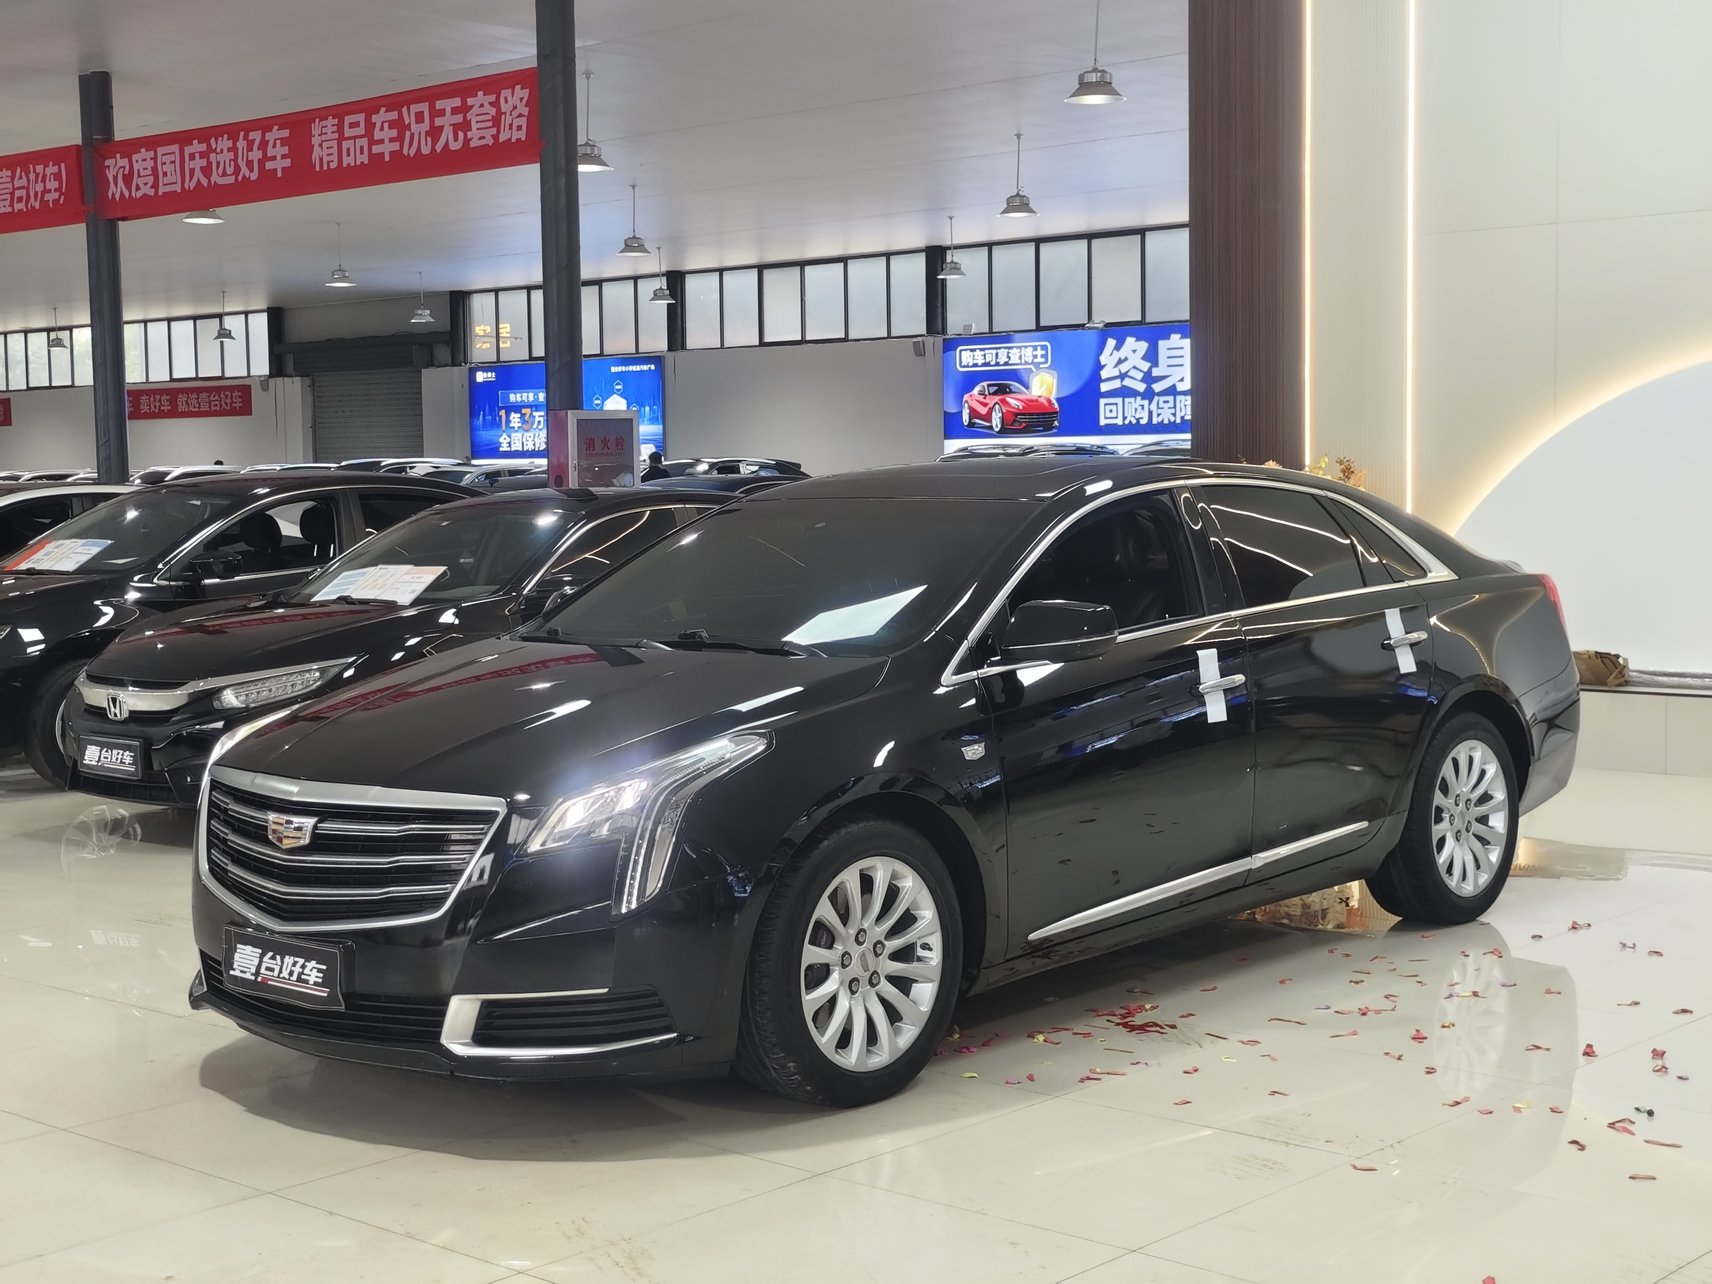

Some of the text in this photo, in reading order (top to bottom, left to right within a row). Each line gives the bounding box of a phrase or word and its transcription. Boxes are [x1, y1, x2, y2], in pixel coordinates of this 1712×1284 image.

[104, 84, 530, 202] 欢度国庆选好车 精品车况无套路
[961, 346, 1046, 366] 购车可享查博士
[1099, 333, 1192, 393] 终身
[140, 394, 171, 413] 卖好车
[177, 391, 243, 412] 就选壹台好车
[499, 432, 547, 452] 全国保修
[83, 744, 135, 766] 壹台好车
[229, 943, 328, 985] 壹台好车
